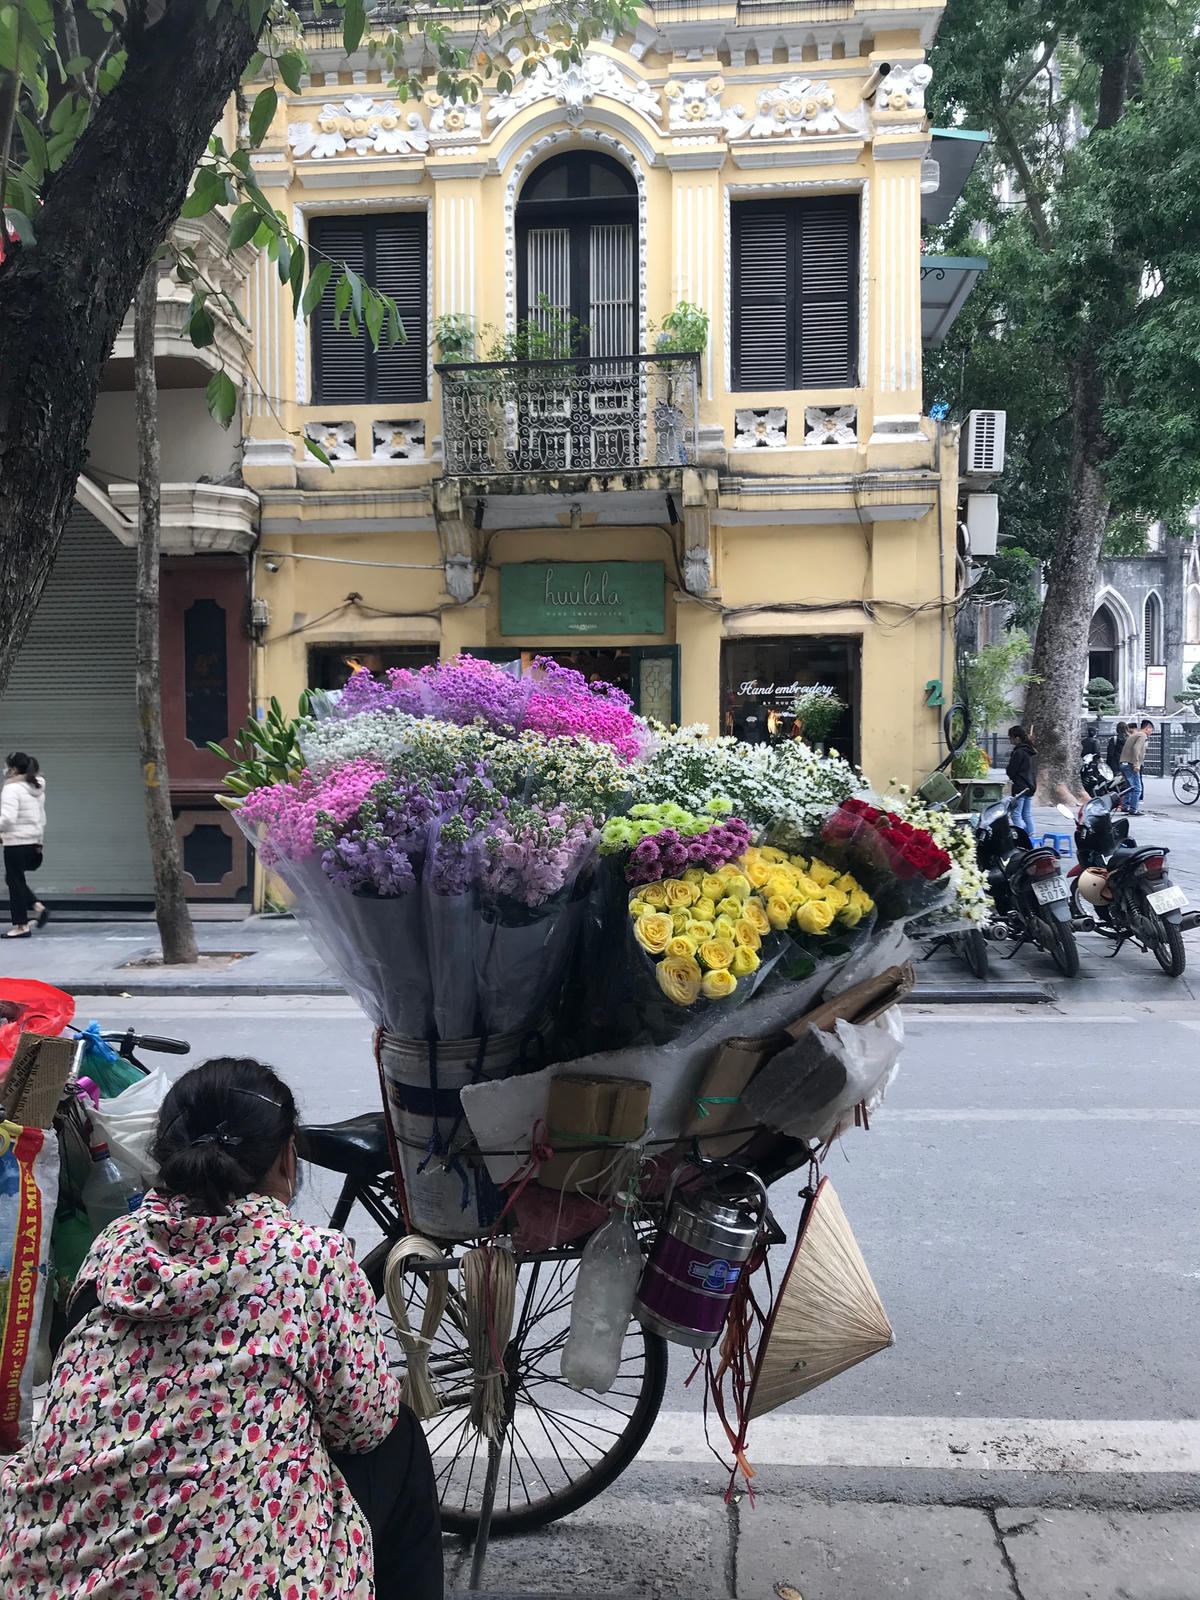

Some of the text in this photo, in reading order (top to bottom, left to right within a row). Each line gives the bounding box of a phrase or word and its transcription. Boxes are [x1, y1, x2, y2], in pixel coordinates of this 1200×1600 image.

[737, 679, 775, 696] Hand
[924, 679, 946, 707] 2
[22, 1215, 37, 1255] LÀI
[16, 1259, 34, 1325] THƠM
